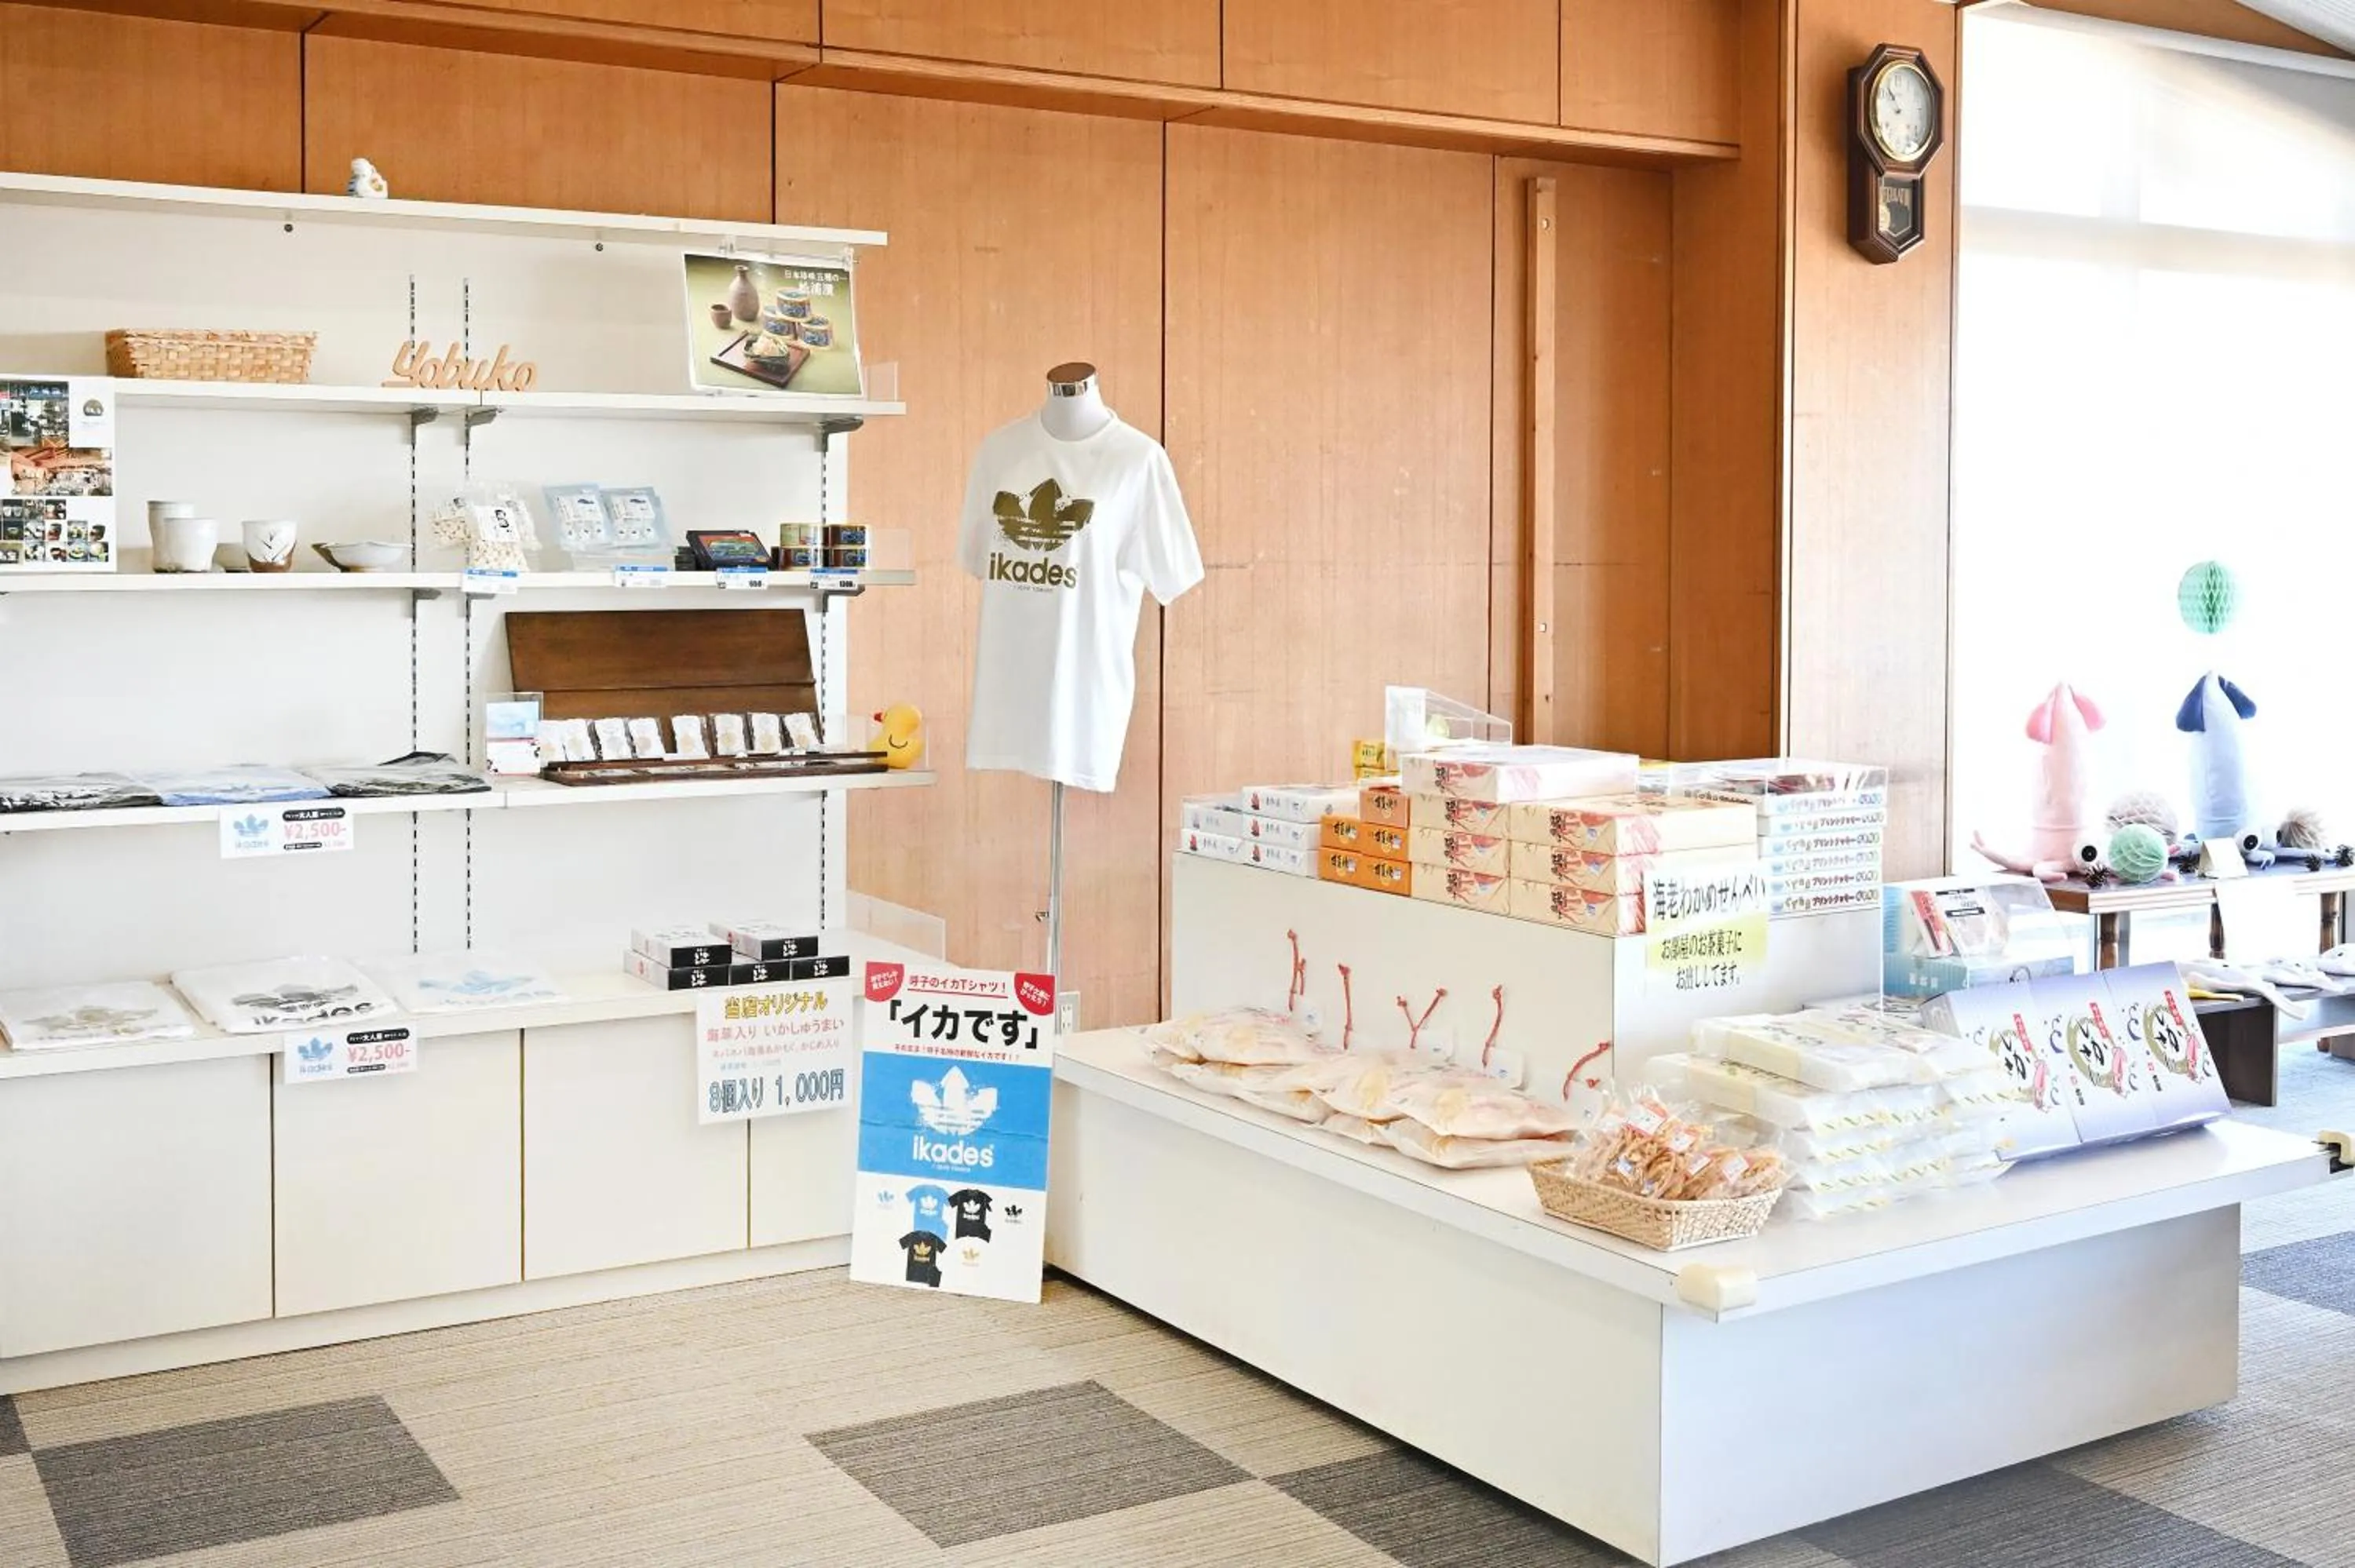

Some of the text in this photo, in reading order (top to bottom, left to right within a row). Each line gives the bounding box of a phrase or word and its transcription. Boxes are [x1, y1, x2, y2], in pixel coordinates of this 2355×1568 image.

[381, 341, 539, 391] Yobuko
[988, 552, 1079, 588] ikades
[1653, 873, 1765, 920] 海老わかめせんべい
[1661, 929, 1742, 961] お部屋のお茶菓子に
[725, 990, 828, 1019] 当店オリジナル
[889, 999, 1039, 1049] 「イカです」
[709, 1076, 764, 1113] 8個入り
[912, 1135, 994, 1168] ikades
